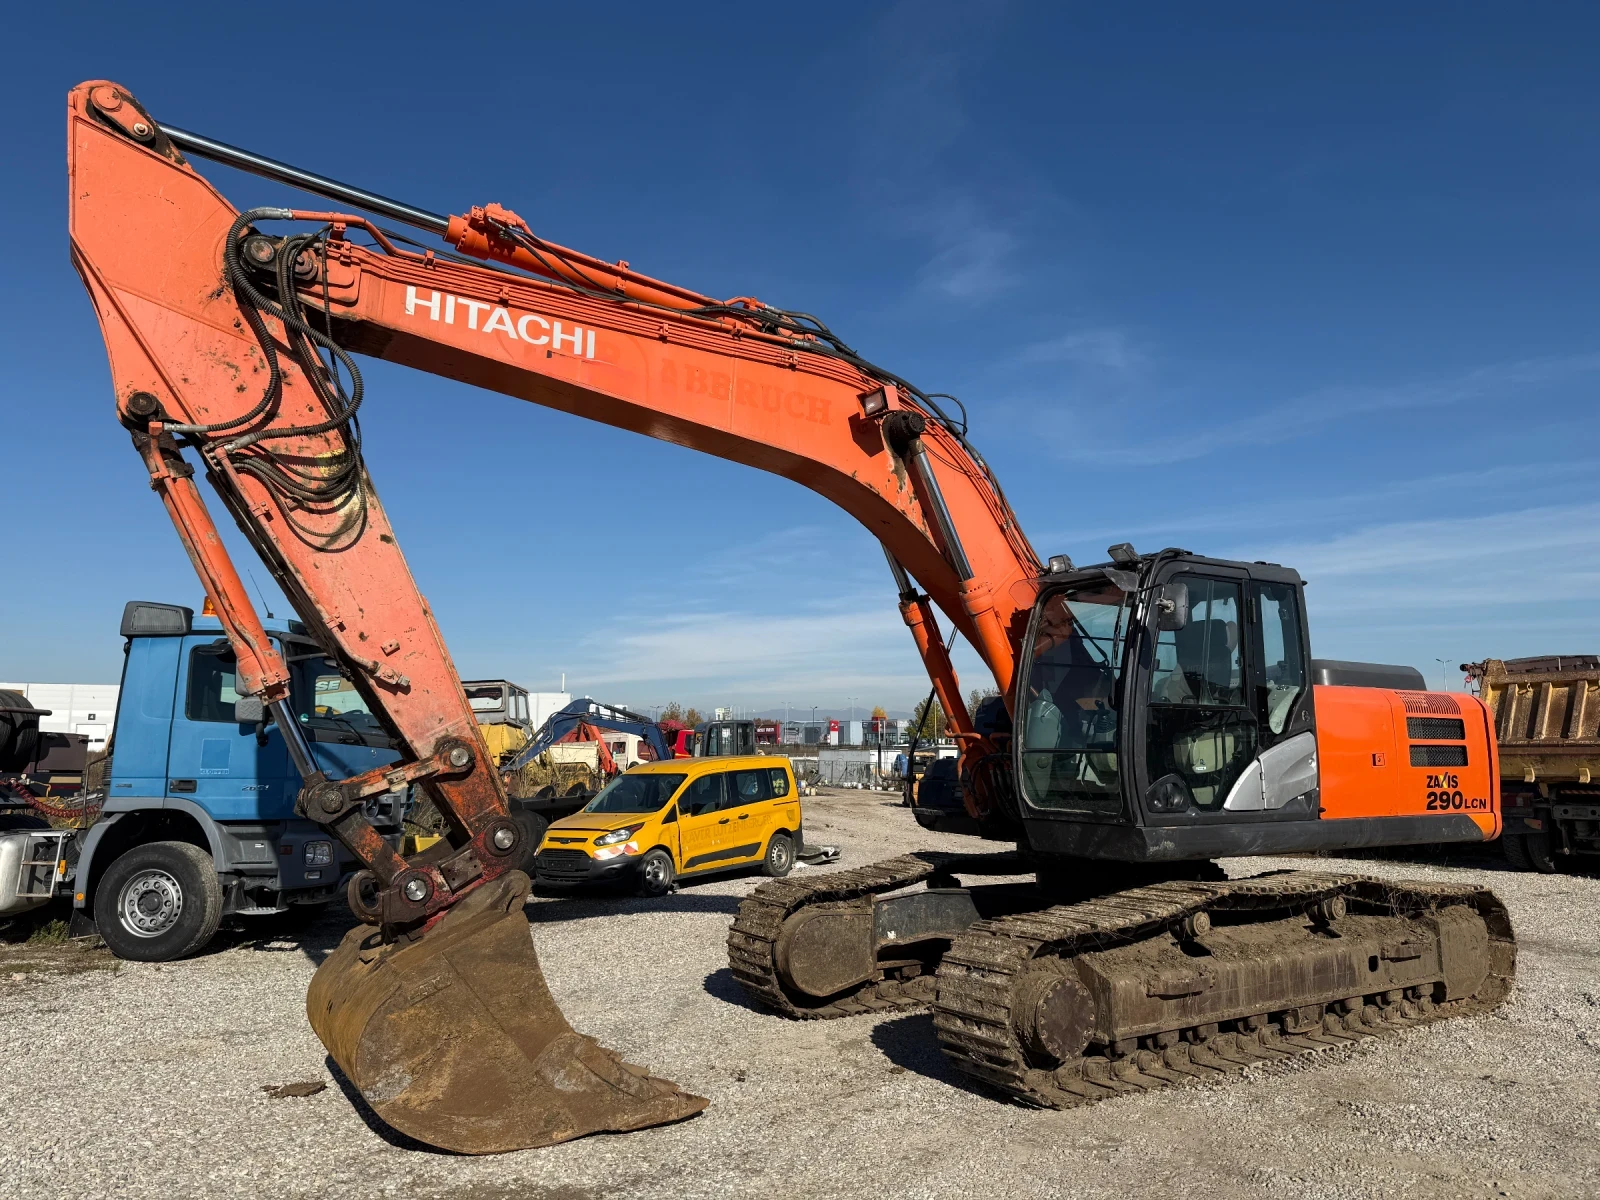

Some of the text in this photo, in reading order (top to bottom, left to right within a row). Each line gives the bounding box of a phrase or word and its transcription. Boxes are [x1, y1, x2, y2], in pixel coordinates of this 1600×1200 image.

[405, 285, 596, 360] HITACHI
[660, 357, 832, 426] ABBRUCH
[315, 680, 341, 691] SE
[1426, 772, 1459, 789] ZAXIS
[1426, 791, 1487, 810] 290 LCN
